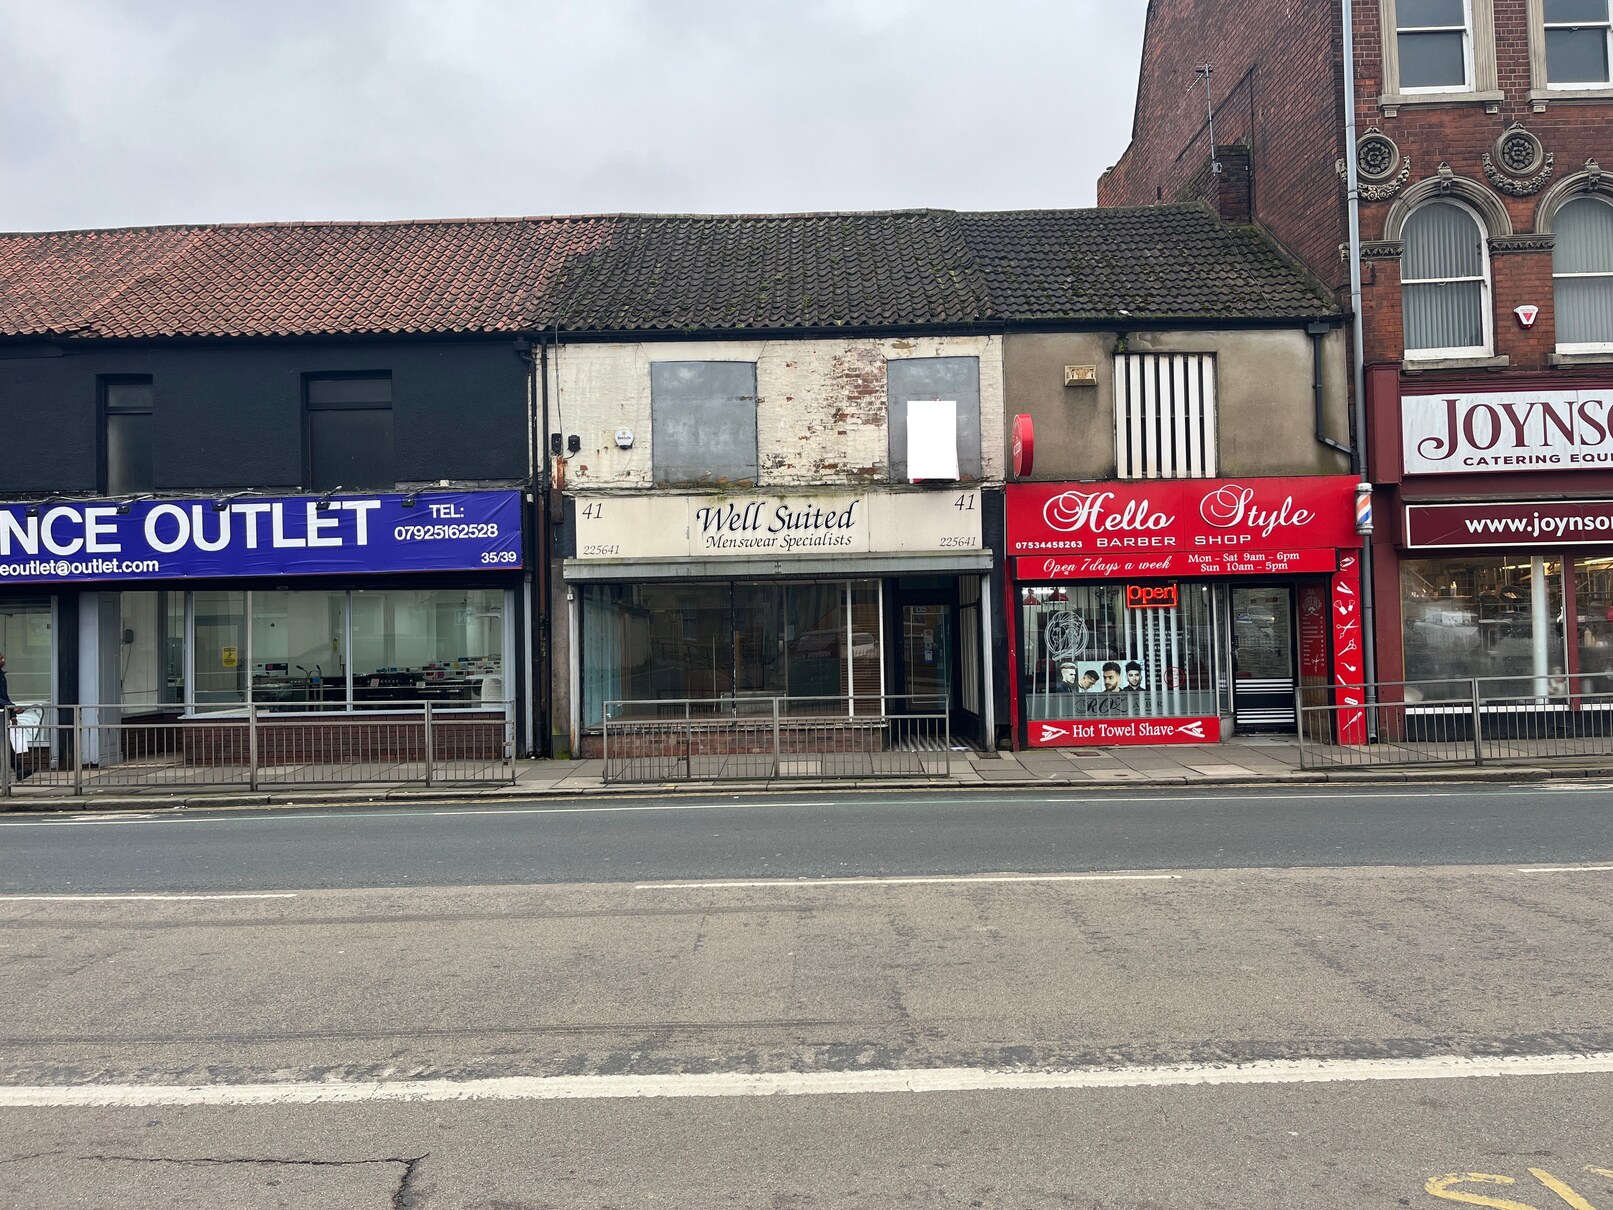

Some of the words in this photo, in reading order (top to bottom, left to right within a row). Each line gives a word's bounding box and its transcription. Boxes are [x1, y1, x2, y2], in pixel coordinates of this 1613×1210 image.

[1417, 398, 1613, 460] JOYNS
[1463, 453, 1561, 466] CATERING
[428, 503, 465, 518] TEL:
[581, 502, 604, 519] 41
[954, 493, 976, 511] 41
[696, 501, 766, 532] Well
[767, 499, 860, 533] Suited
[1043, 490, 1175, 533] Hello
[1199, 484, 1316, 538] Style
[0, 505, 122, 556] NCE
[144, 499, 382, 553] OUTLET
[394, 523, 499, 541] 07925162528
[1465, 511, 1613, 538] www.joynso
[583, 544, 620, 555] 225641
[705, 534, 778, 549] Menswear
[779, 531, 852, 551] Specialists
[939, 536, 976, 547] 225641
[1015, 540, 1084, 549] 07534458263
[1096, 536, 1177, 548] BARBER
[1194, 534, 1252, 545] SHOP
[480, 551, 517, 563] 35/39
[1188, 554, 1212, 563] Mon
[1222, 553, 1239, 562] Sat
[1243, 552, 1266, 562] 9am
[1276, 551, 1300, 562] 6pm
[0, 557, 160, 576] eoutlet@outlet.com
[1043, 558, 1077, 578] Open
[1124, 562, 1135, 571] a
[1138, 555, 1173, 570] week
[1200, 563, 1220, 572] Sun
[1226, 562, 1254, 571] 10am
[1265, 561, 1288, 571] 5pm
[1128, 585, 1175, 604] Open
[1073, 724, 1095, 737] Hot
[1099, 722, 1135, 737] Towel
[1138, 721, 1174, 736] Shave
